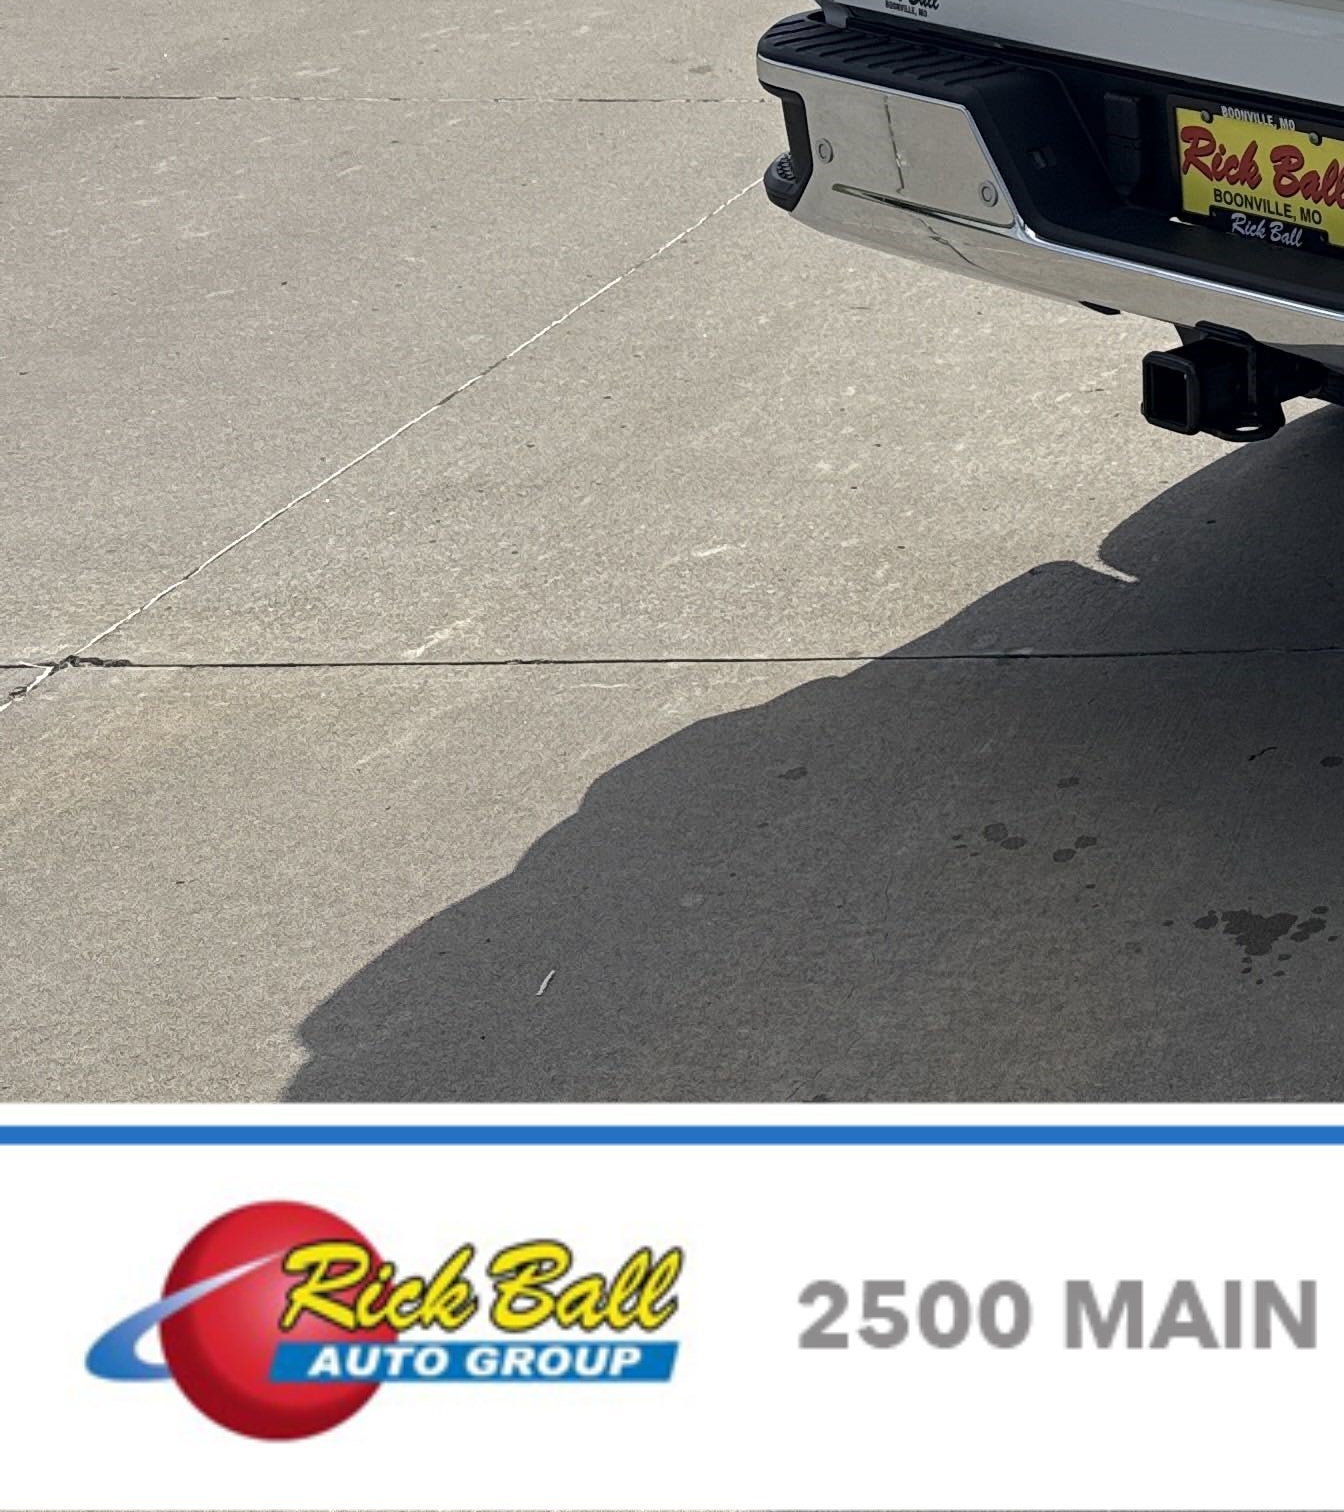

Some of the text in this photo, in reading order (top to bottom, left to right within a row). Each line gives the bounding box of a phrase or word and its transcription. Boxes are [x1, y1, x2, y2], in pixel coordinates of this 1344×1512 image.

[918, 8, 928, 18] MO
[1221, 105, 1296, 131] BOONVILLE, MO
[1180, 125, 1263, 190] Rick
[1214, 188, 1323, 225] BOONVILLE, MO
[1231, 213, 1303, 248] Rick Ball
